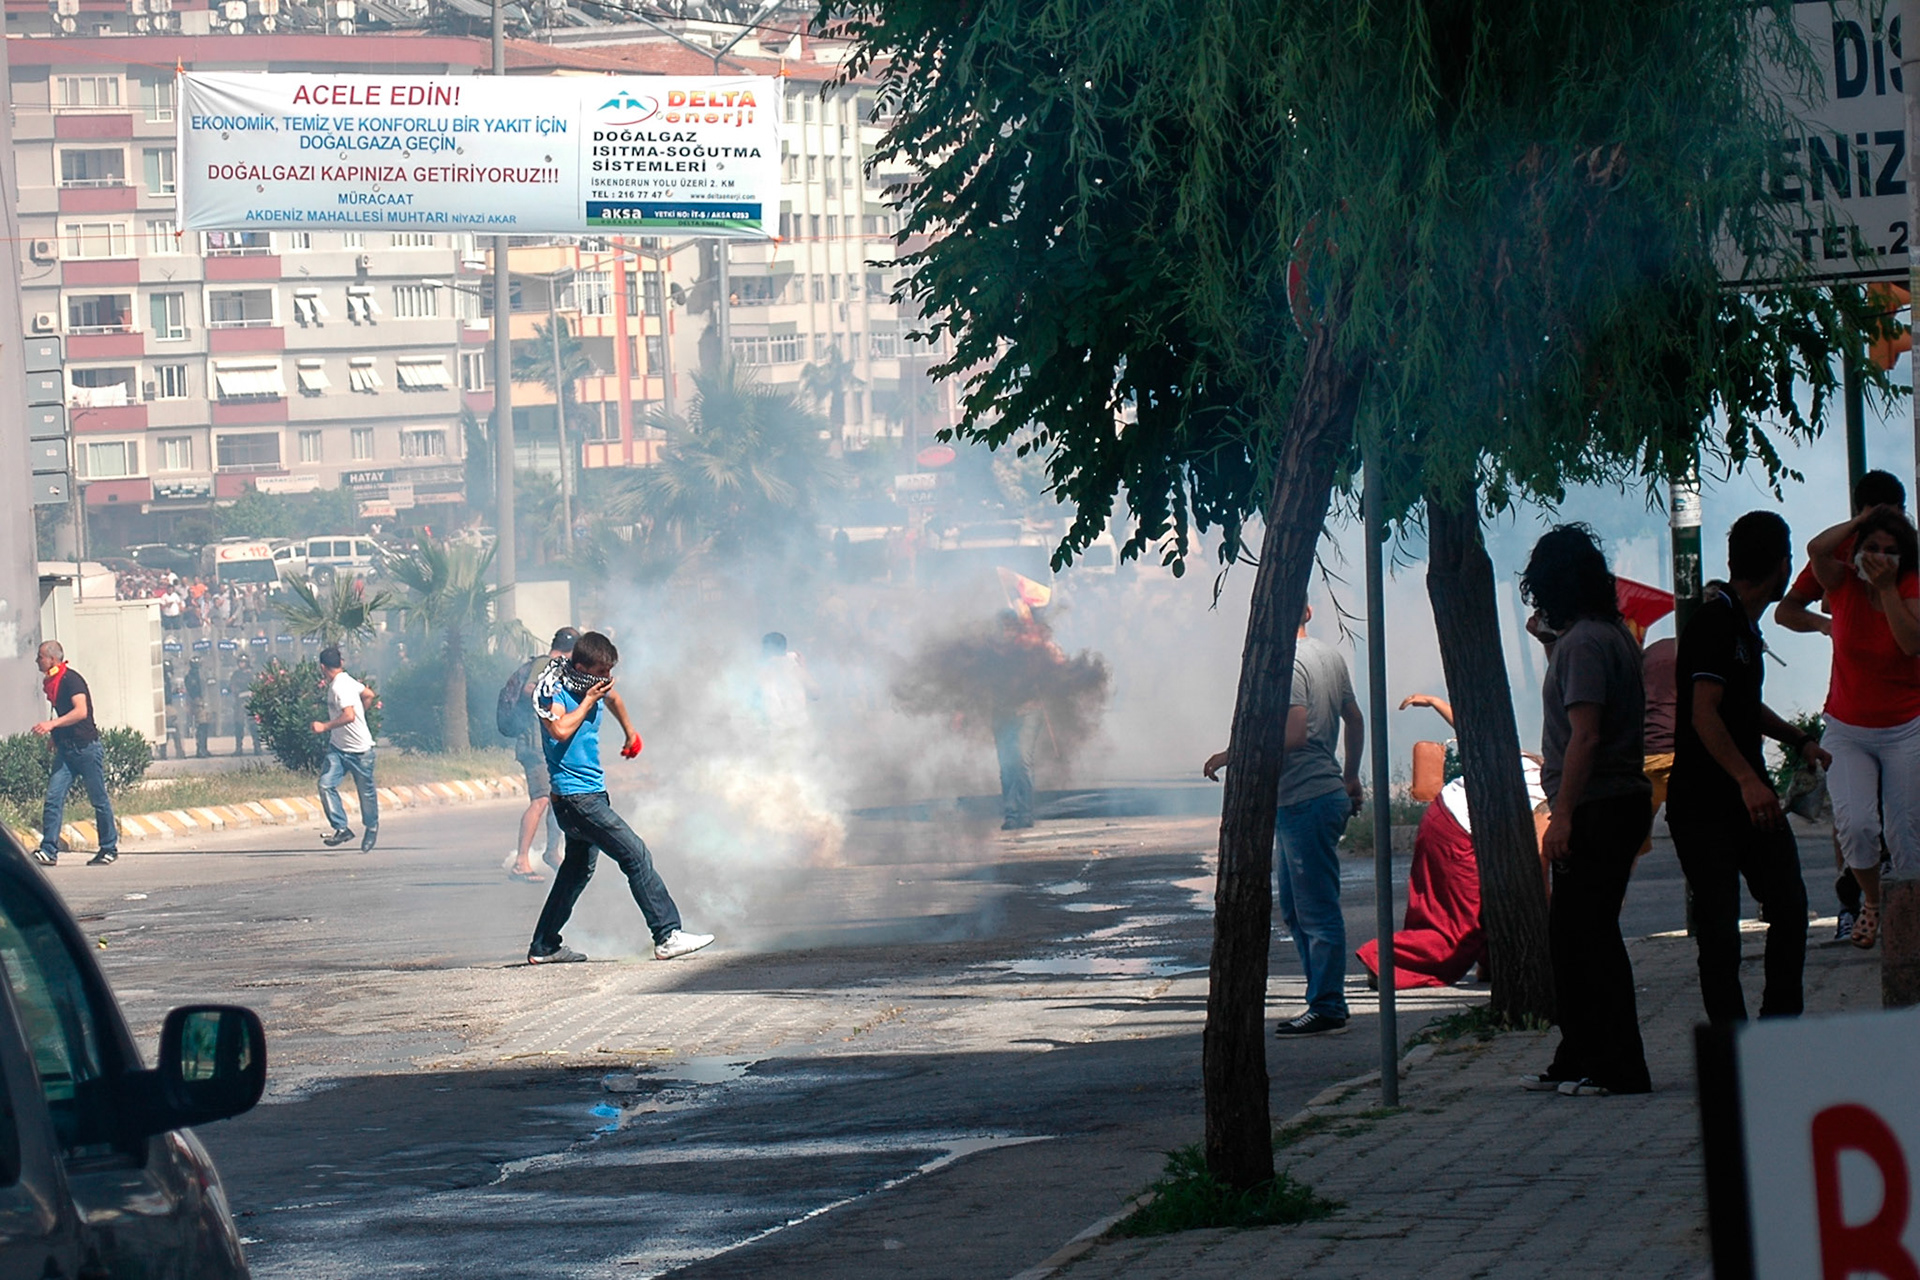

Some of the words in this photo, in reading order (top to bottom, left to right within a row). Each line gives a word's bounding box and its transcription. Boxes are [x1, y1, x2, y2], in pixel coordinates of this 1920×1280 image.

[293, 85, 381, 105] ACELE
[390, 81, 461, 106] EDİN!
[668, 90, 757, 108] DELTA
[191, 114, 279, 132] EKONOMİK,
[282, 114, 330, 132] TEMİZ
[332, 117, 354, 132] VE
[358, 117, 448, 133] KONFORLU
[453, 115, 480, 133] BİR
[485, 118, 532, 134] YAKIT
[535, 115, 567, 136] İÇİN
[665, 110, 754, 127] enerji
[593, 129, 697, 142] DOĞALGAZ
[300, 133, 401, 150] DOĞALGAZA
[405, 134, 456, 154] GEÇİN
[592, 144, 762, 158] ISITMA-SOĞUTMA
[592, 158, 707, 172] SİSTEMLERİ
[207, 161, 315, 181] DOĞALGAZI
[321, 165, 407, 182] KAPINIZA
[413, 163, 559, 184] GETİRİYORUZ!!!
[591, 177, 650, 187] İSKENDERUN
[653, 179, 677, 187] YOLU
[680, 177, 707, 188] ÜZERİ
[710, 180, 718, 188] 2.
[721, 180, 735, 188] KM
[337, 192, 414, 205] MÜRACAAT
[592, 190, 609, 199] TEL
[618, 190, 636, 199] 216
[637, 190, 649, 199] 77
[651, 191, 663, 199] 47
[245, 206, 303, 222] AKDENİZ
[307, 207, 384, 223] MAHALLESİ
[387, 209, 449, 224] MUHTARI
[451, 211, 485, 224] NİYAZİ
[487, 214, 517, 224] AKAR
[601, 208, 642, 219] aksa
[654, 210, 675, 218] YETKİ
[711, 211, 731, 219] AKSA
[349, 471, 385, 484] HATAY
[248, 545, 270, 558] 112
